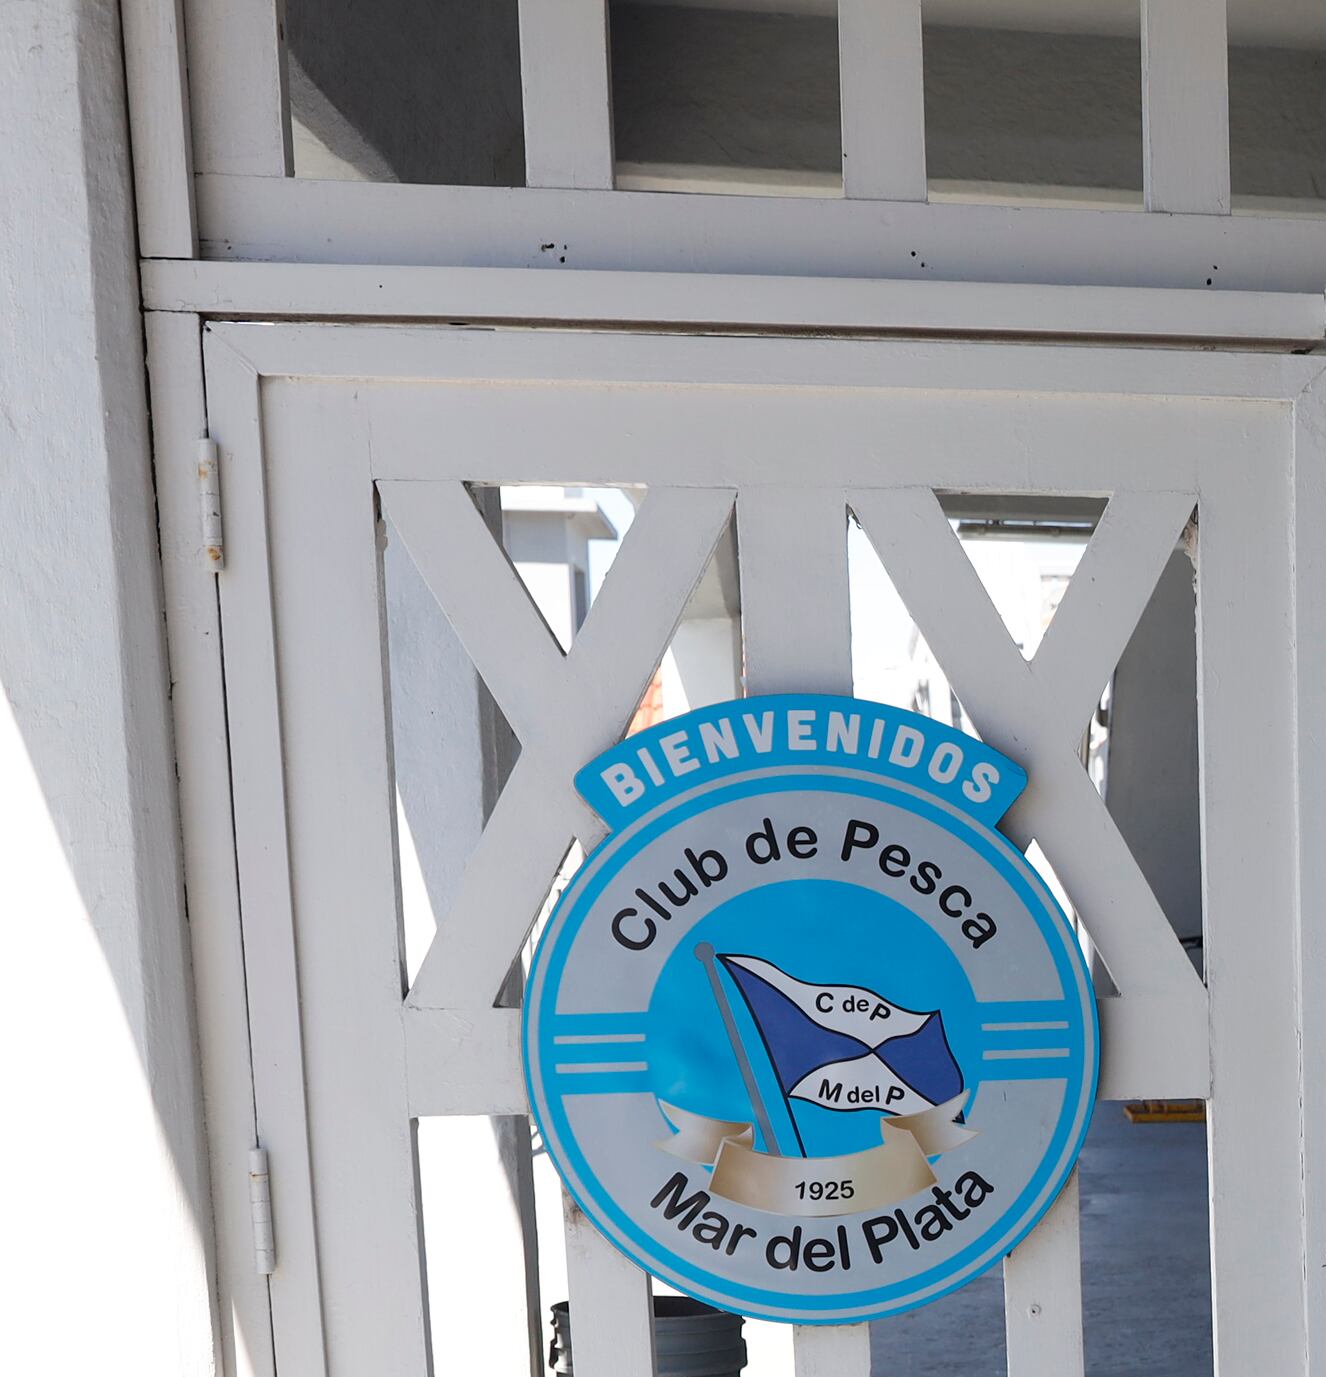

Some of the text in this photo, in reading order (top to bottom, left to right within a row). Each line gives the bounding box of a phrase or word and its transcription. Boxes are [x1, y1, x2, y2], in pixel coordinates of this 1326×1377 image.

[600, 709, 1001, 807] BIENVENIDOS
[611, 817, 998, 952] Club de Pesca
[815, 992, 834, 1014] C
[818, 1079, 905, 1107] M del P
[795, 1179, 855, 1201] 1925
[650, 1170, 995, 1274] Mar del Plata
